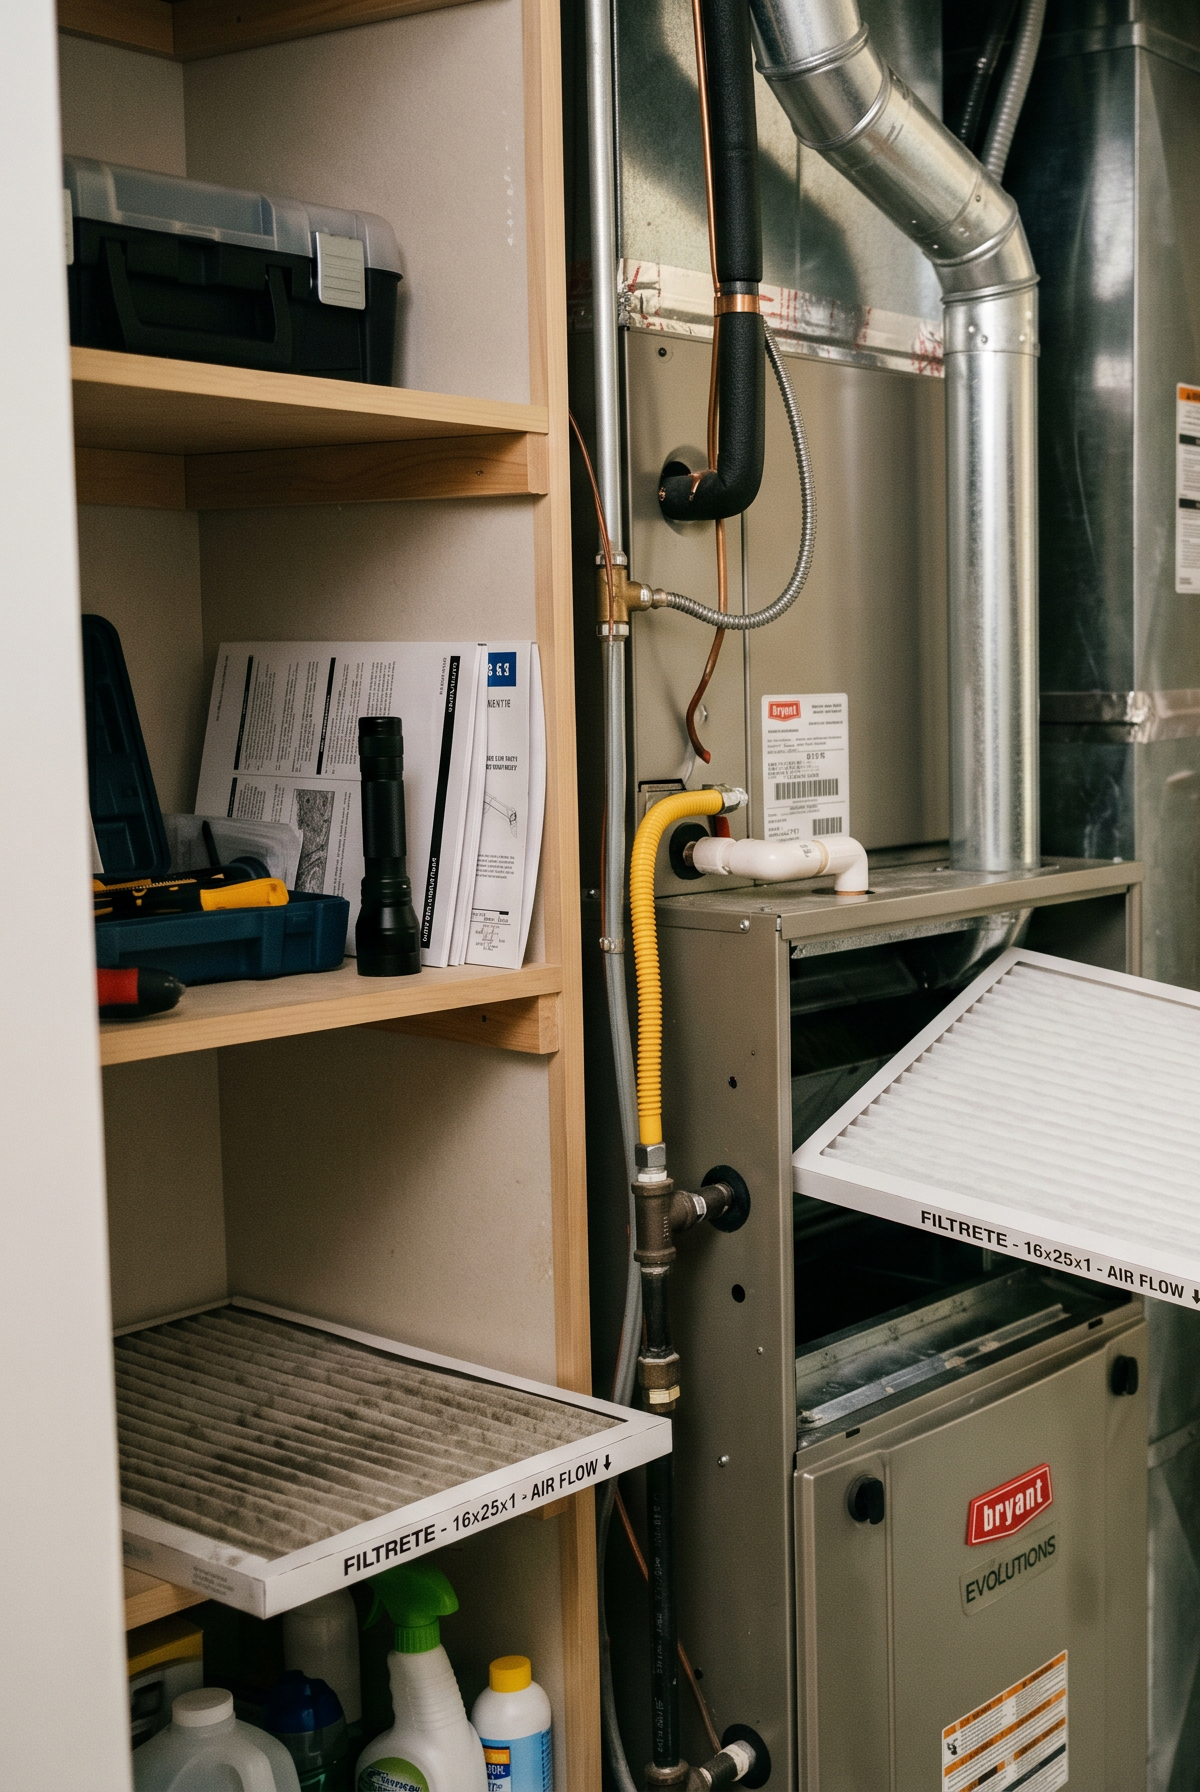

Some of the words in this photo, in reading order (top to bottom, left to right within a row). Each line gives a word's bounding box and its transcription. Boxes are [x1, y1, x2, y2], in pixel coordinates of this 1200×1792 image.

[920, 1210, 1008, 1248] FILTRETE
[1023, 1241, 1091, 1272] 16x25x1
[1107, 1265, 1134, 1285] AIR
[1139, 1275, 1184, 1299] FLOW
[343, 1523, 436, 1576] FILTRETE
[452, 1493, 516, 1532] 16x25x1
[530, 1477, 555, 1501] AIR
[559, 1458, 598, 1490] FLOW
[983, 1478, 1043, 1532] bryant
[965, 1534, 1056, 1604] EVOLUTIONS
